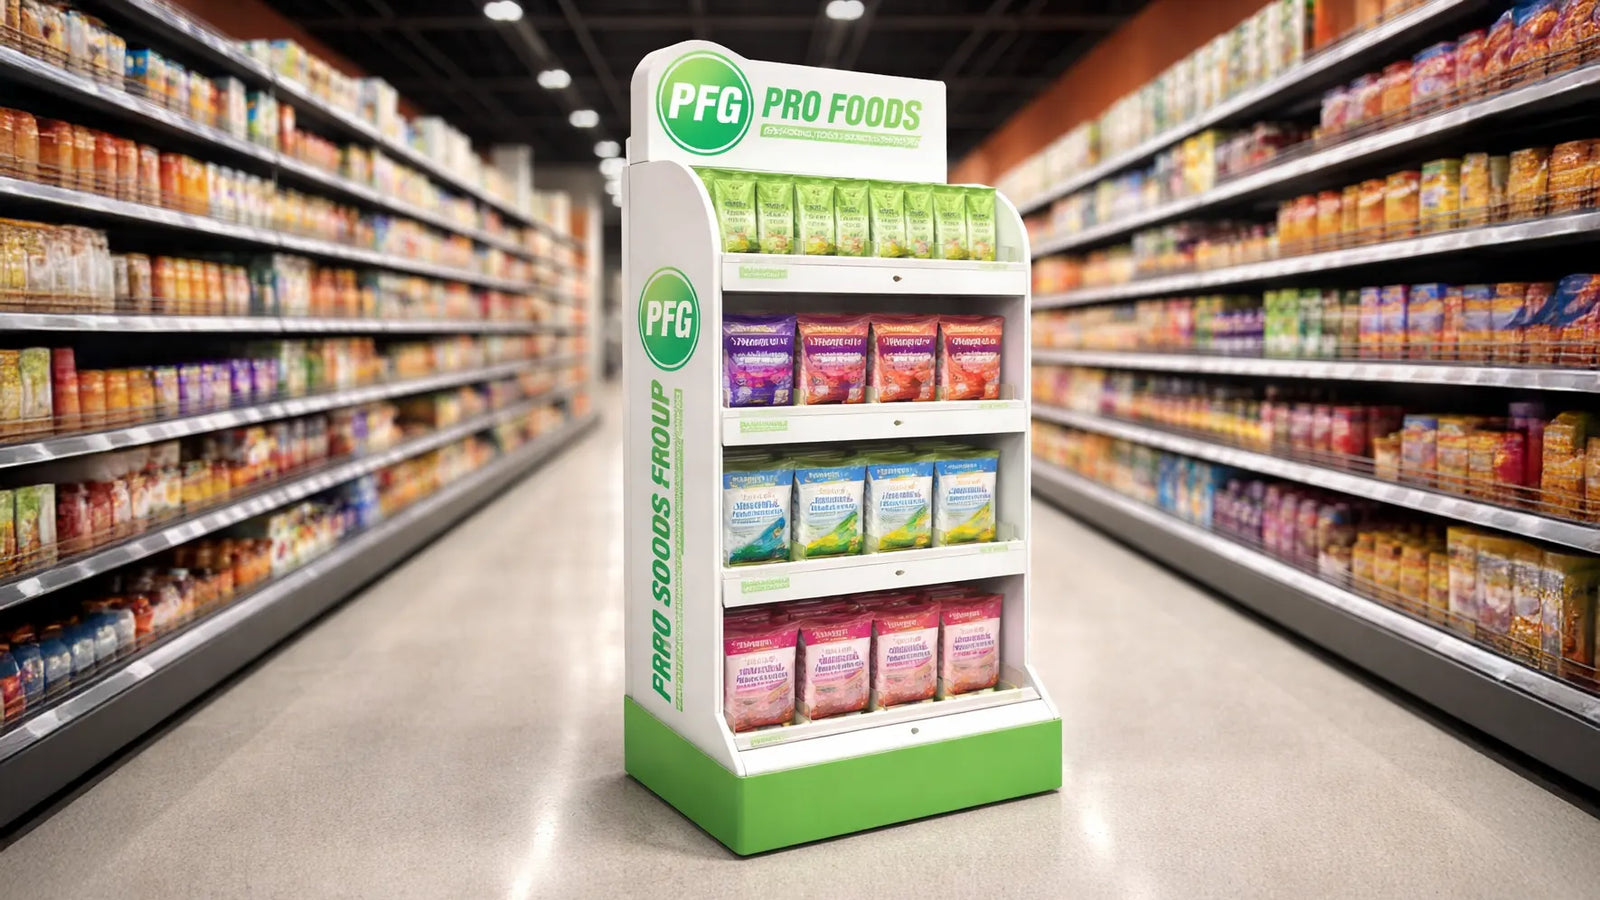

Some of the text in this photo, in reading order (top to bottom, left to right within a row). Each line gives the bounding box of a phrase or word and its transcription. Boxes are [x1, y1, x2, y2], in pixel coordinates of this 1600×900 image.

[668, 82, 743, 124] PFG
[761, 86, 923, 131] PRO FOODS
[645, 300, 693, 338] PFG
[651, 379, 671, 490] FROUP
[651, 493, 671, 608] SOODS
